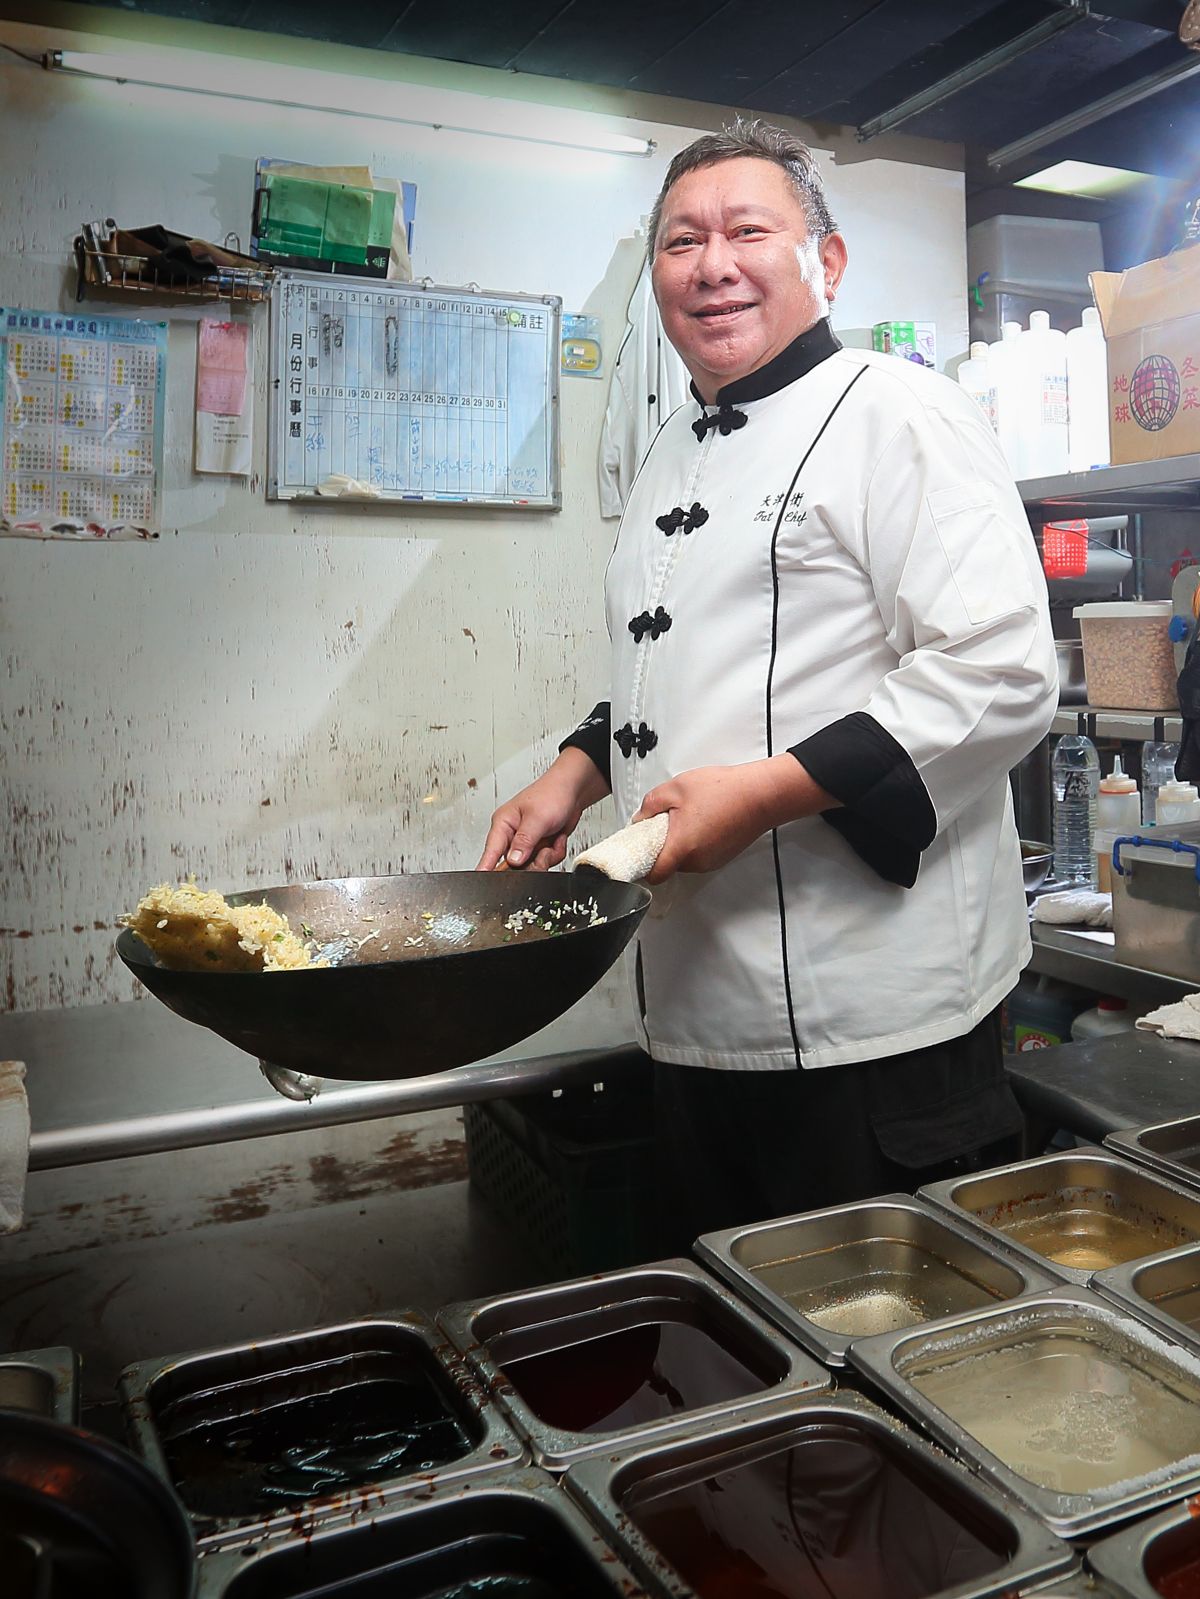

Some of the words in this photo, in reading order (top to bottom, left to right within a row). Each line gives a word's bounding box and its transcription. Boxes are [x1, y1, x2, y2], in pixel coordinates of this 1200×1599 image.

[325, 291, 329, 299] 1
[337, 292, 343, 300] 2
[351, 293, 356, 302] 3
[363, 295, 369, 303] 4
[376, 296, 382, 304] 5
[389, 297, 395, 306] 6
[402, 299, 407, 307] 7
[415, 300, 420, 308] 8
[427, 301, 432, 309] 9
[438, 301, 446, 310] 10
[450, 303, 458, 312] 11
[462, 303, 470, 313] 12
[475, 305, 483, 314] 13
[487, 306, 495, 315] 14
[499, 308, 507, 317] 15
[289, 333, 303, 438] 月份行事曆
[308, 386, 317, 395] 16
[321, 387, 330, 396] 17
[334, 388, 343, 397] 18
[347, 389, 357, 398] 19
[360, 390, 370, 399] 20
[374, 391, 383, 400] 21
[386, 392, 396, 401] 22
[399, 392, 409, 401] 23
[411, 393, 421, 402] 24
[424, 394, 434, 403] 25
[436, 395, 446, 405] 26
[449, 396, 458, 405] 27
[461, 397, 470, 406] 28
[473, 398, 482, 407] 29
[485, 399, 494, 408] 30
[498, 400, 506, 409] 31
[1113, 373, 1132, 424] 地球
[1180, 356, 1200, 412] 冬菜
[784, 510, 808, 527] Chef
